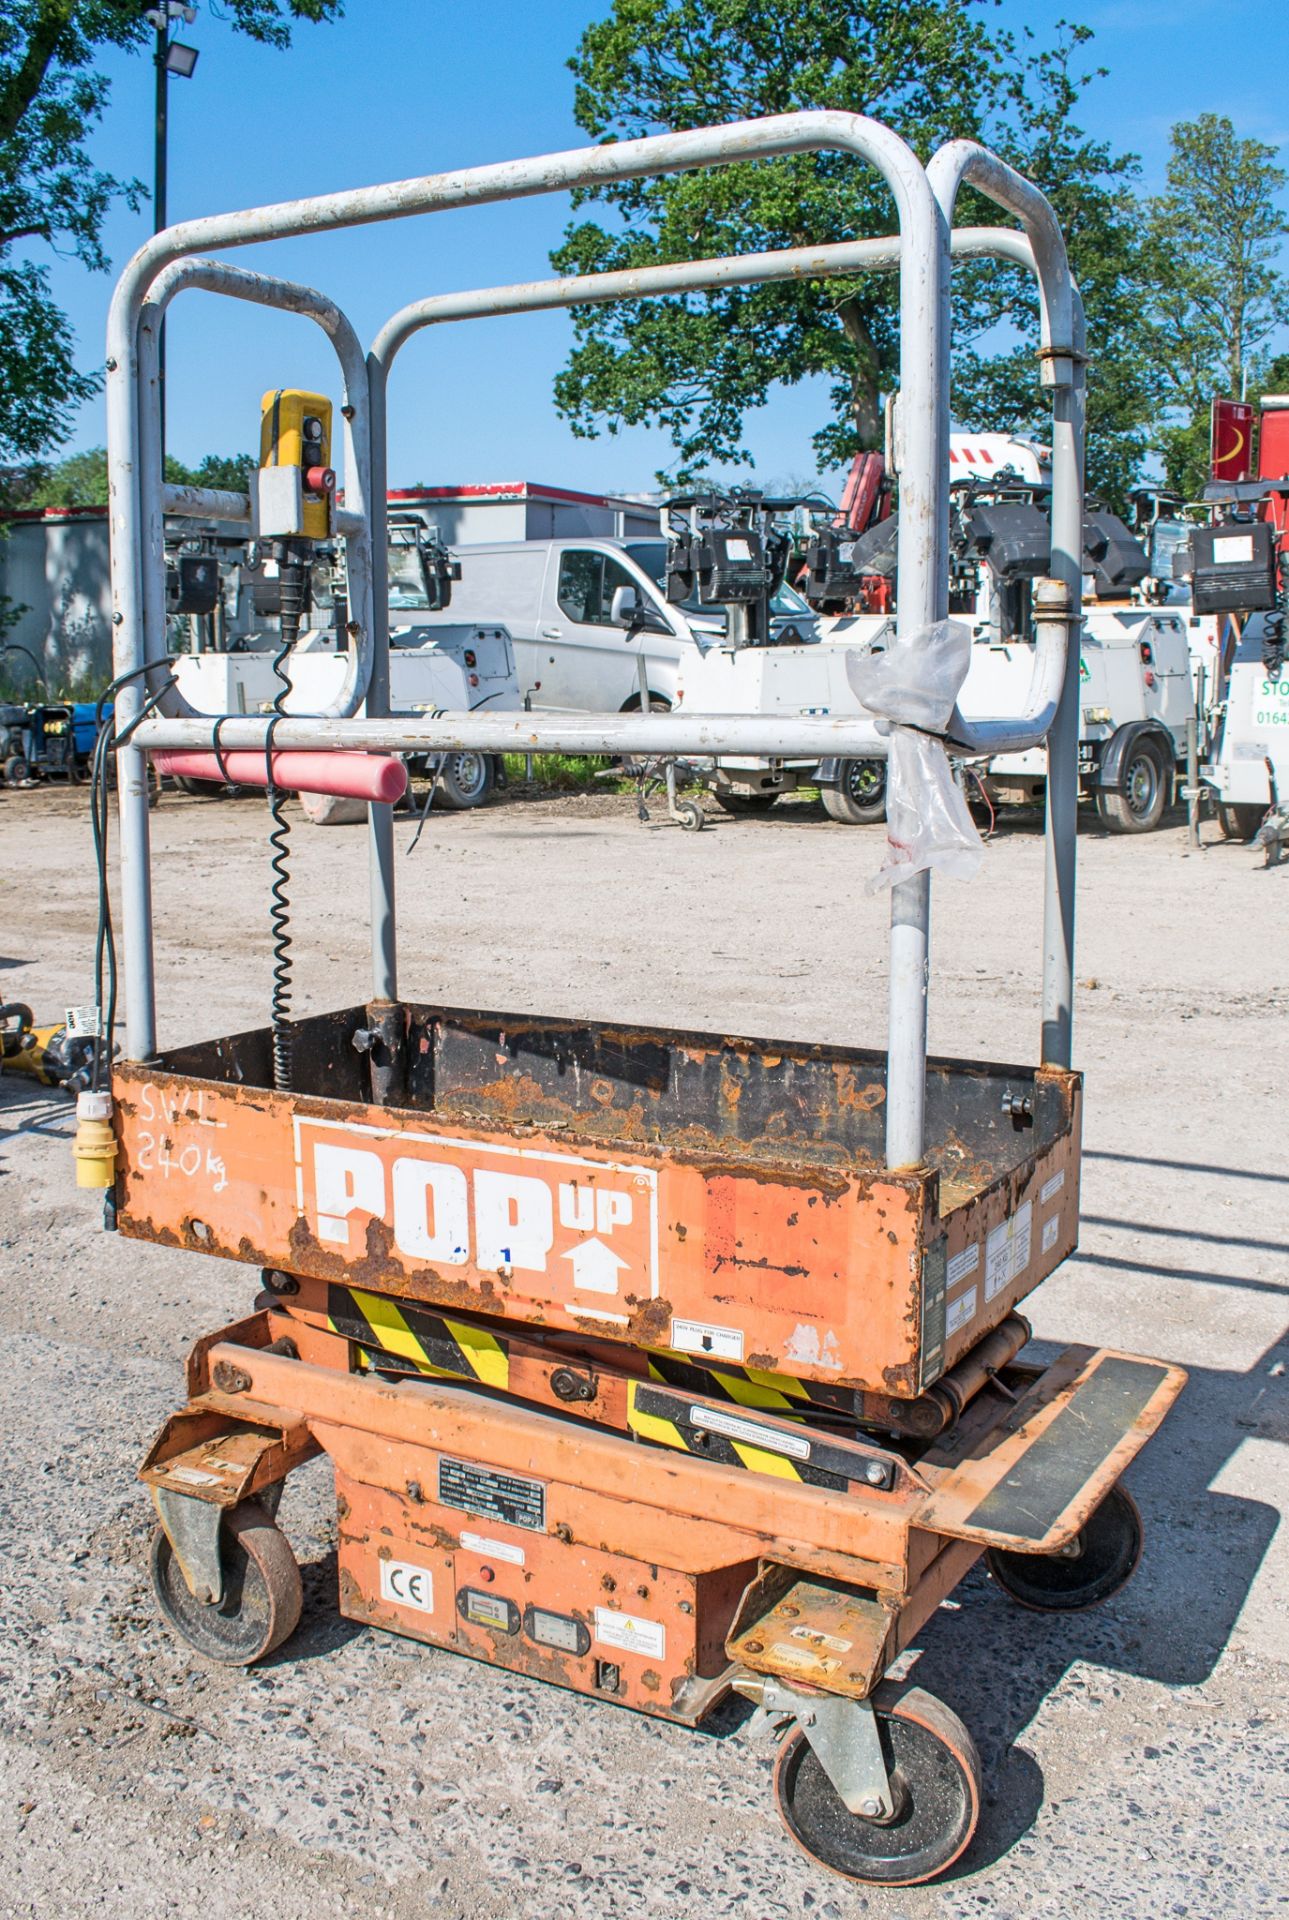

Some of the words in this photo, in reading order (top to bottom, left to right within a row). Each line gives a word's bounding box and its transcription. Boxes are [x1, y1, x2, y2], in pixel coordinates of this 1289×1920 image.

[313, 1142, 554, 1274] POP
[559, 1182, 633, 1236] UP
[390, 1569, 423, 1604] CE
